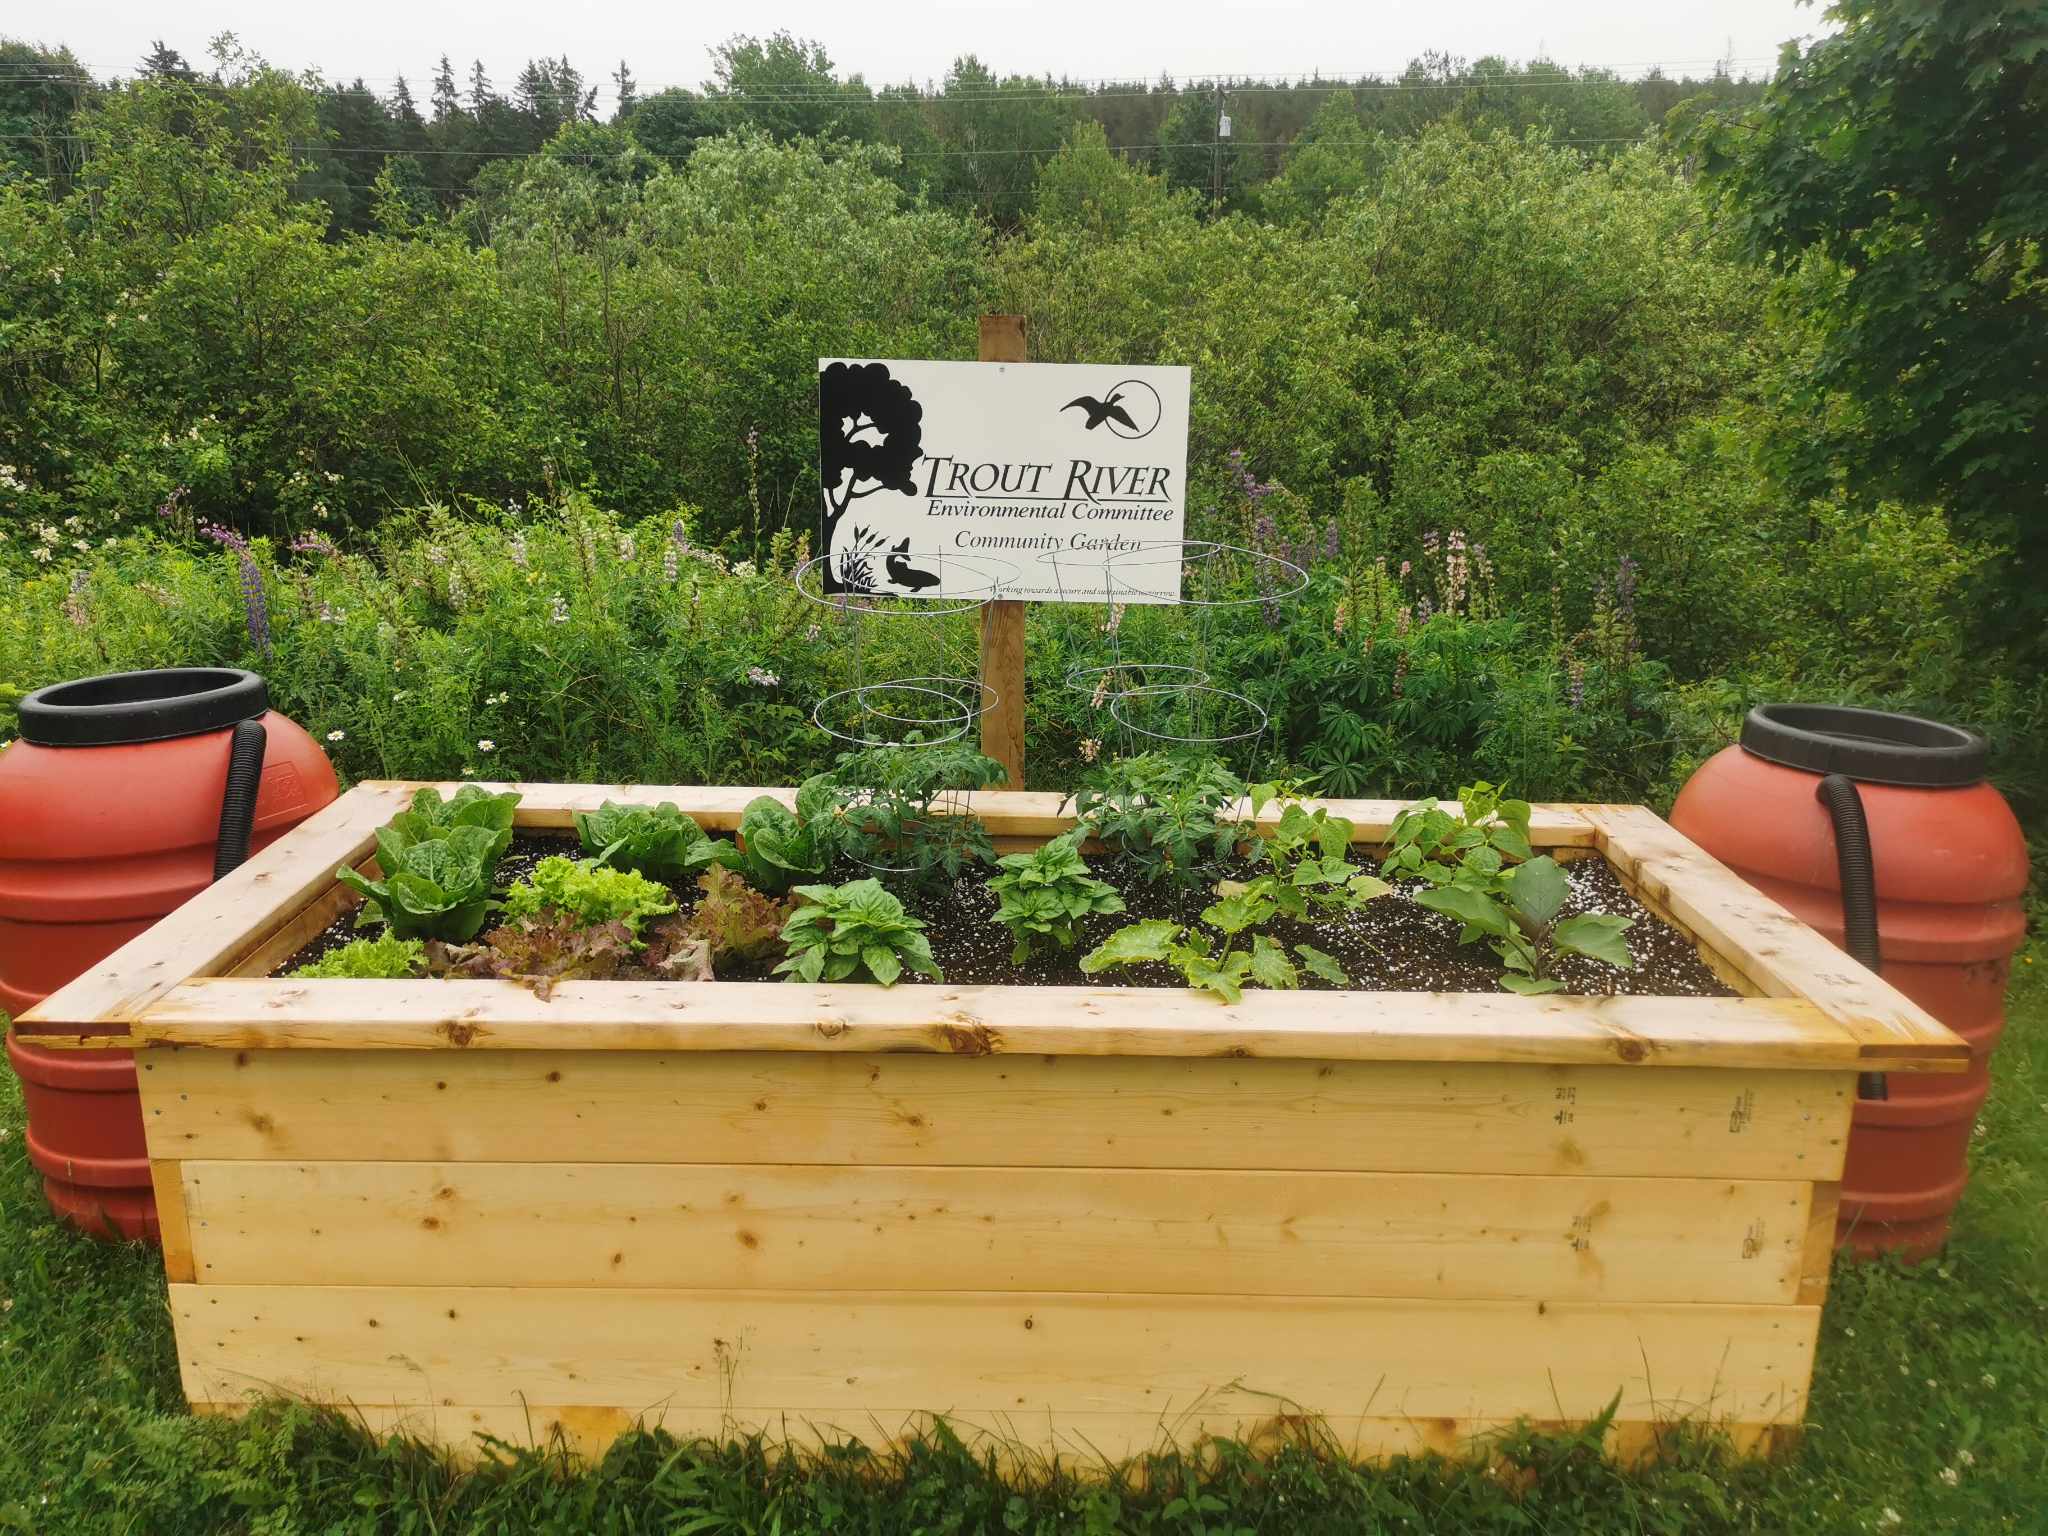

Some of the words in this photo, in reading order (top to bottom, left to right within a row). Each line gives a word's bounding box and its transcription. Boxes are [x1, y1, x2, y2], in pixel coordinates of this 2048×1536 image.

[921, 454, 1053, 498] TROUT
[1062, 459, 1172, 505] RIVER
[927, 499, 1067, 519] Environmental
[1071, 502, 1174, 521] Committee
[955, 530, 1064, 550] Community
[1070, 532, 1142, 551] Garden
[989, 585, 1023, 596] orking
